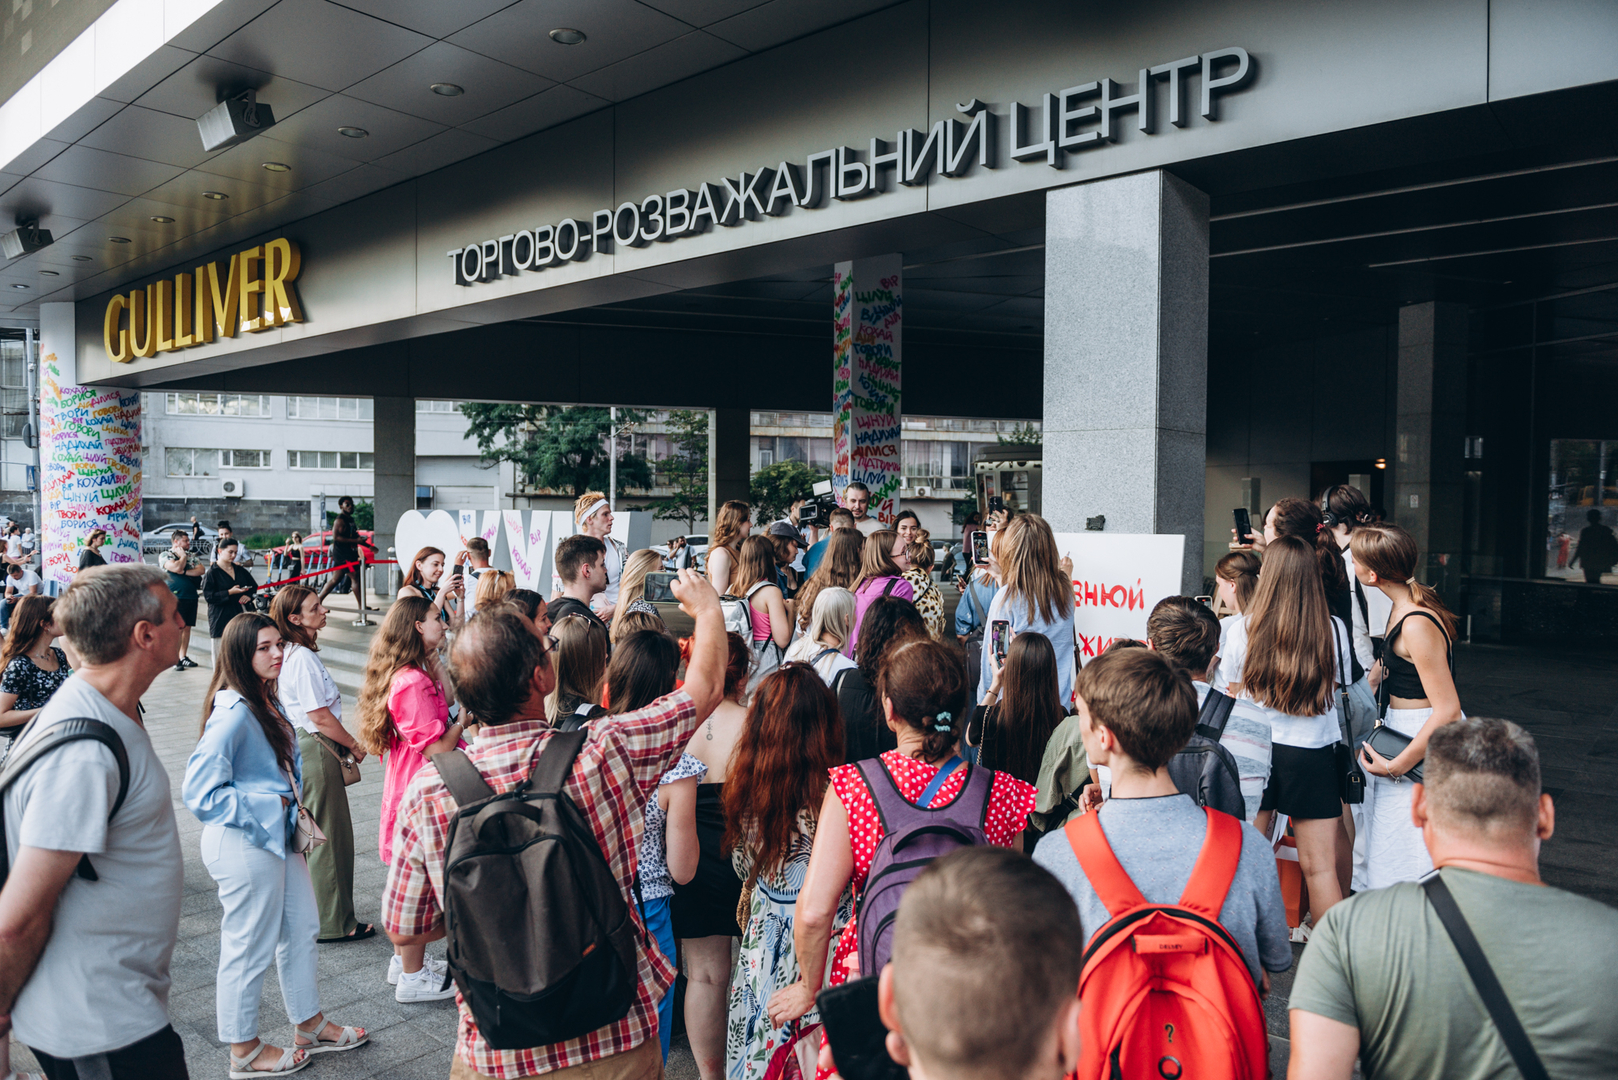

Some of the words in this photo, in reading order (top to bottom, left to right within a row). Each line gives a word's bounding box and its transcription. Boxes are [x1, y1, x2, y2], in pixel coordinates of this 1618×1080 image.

[447, 98, 993, 286] ТОРГОВО-РОЗВАЖАЛЬНИЙ
[1010, 46, 1253, 169] ЦЕНТР
[104, 237, 303, 363] GULLIVER
[60, 389, 97, 409] БОРИСЯ
[91, 390, 121, 409] ДІЛИСЯ
[54, 407, 89, 421] ТВОРИ
[85, 413, 115, 426] КОХАЙ
[63, 420, 100, 440] ГОВОРИ
[54, 439, 103, 454] НАДИХАЙ
[52, 451, 84, 463] КОХАЙ
[76, 472, 116, 489] КОХАЙ
[63, 489, 100, 503] ЦІНУЙ
[868, 474, 901, 510] ОХАЙ
[56, 509, 87, 520] ТВОРИ
[96, 496, 128, 516] КОХАЙ
[60, 518, 99, 529] БОРИСЯ
[529, 529, 542, 546] ВІР
